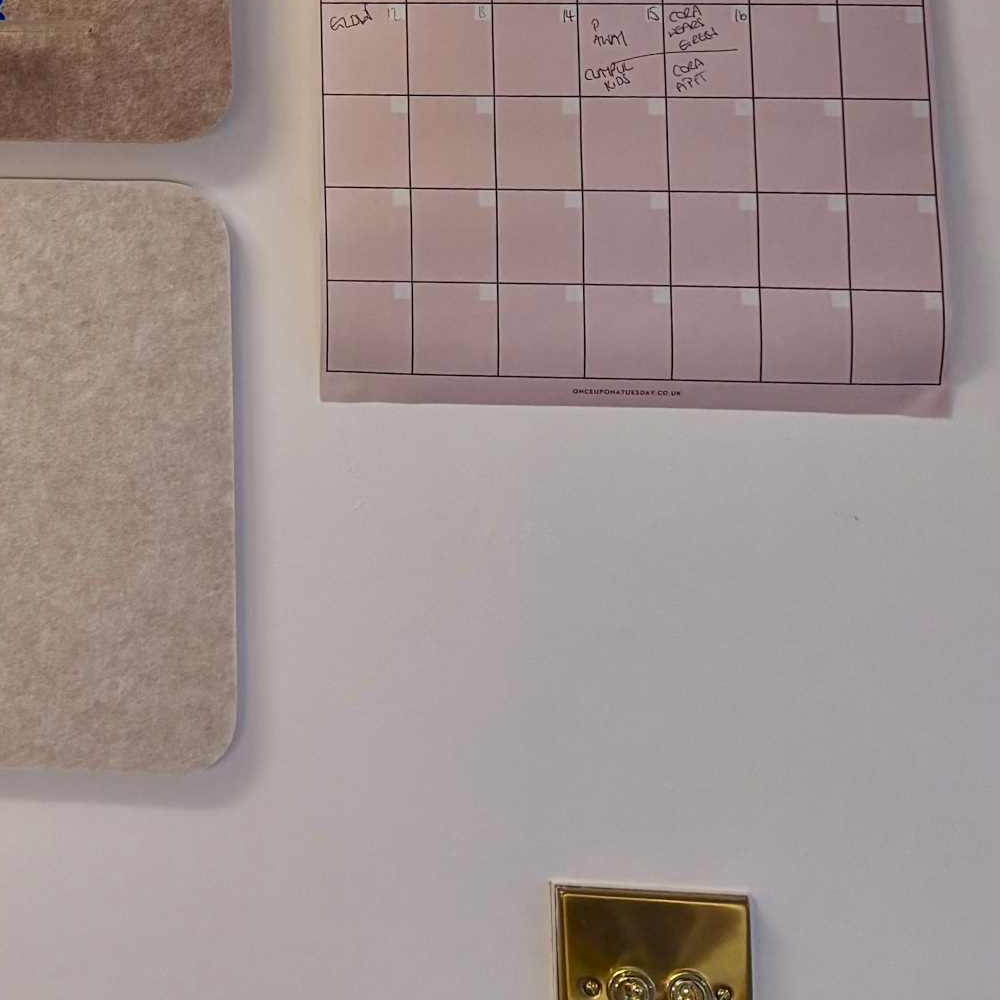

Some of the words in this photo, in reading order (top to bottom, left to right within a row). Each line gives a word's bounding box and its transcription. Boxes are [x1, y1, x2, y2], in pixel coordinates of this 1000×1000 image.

[563, 9, 576, 23] 14
[647, 6, 660, 21] 15
[669, 5, 703, 23] CORA
[734, 10, 748, 23] 16
[672, 58, 705, 77] CORA
[572, 388, 682, 396] ONCEUPONATUESDAY.CO.UK
